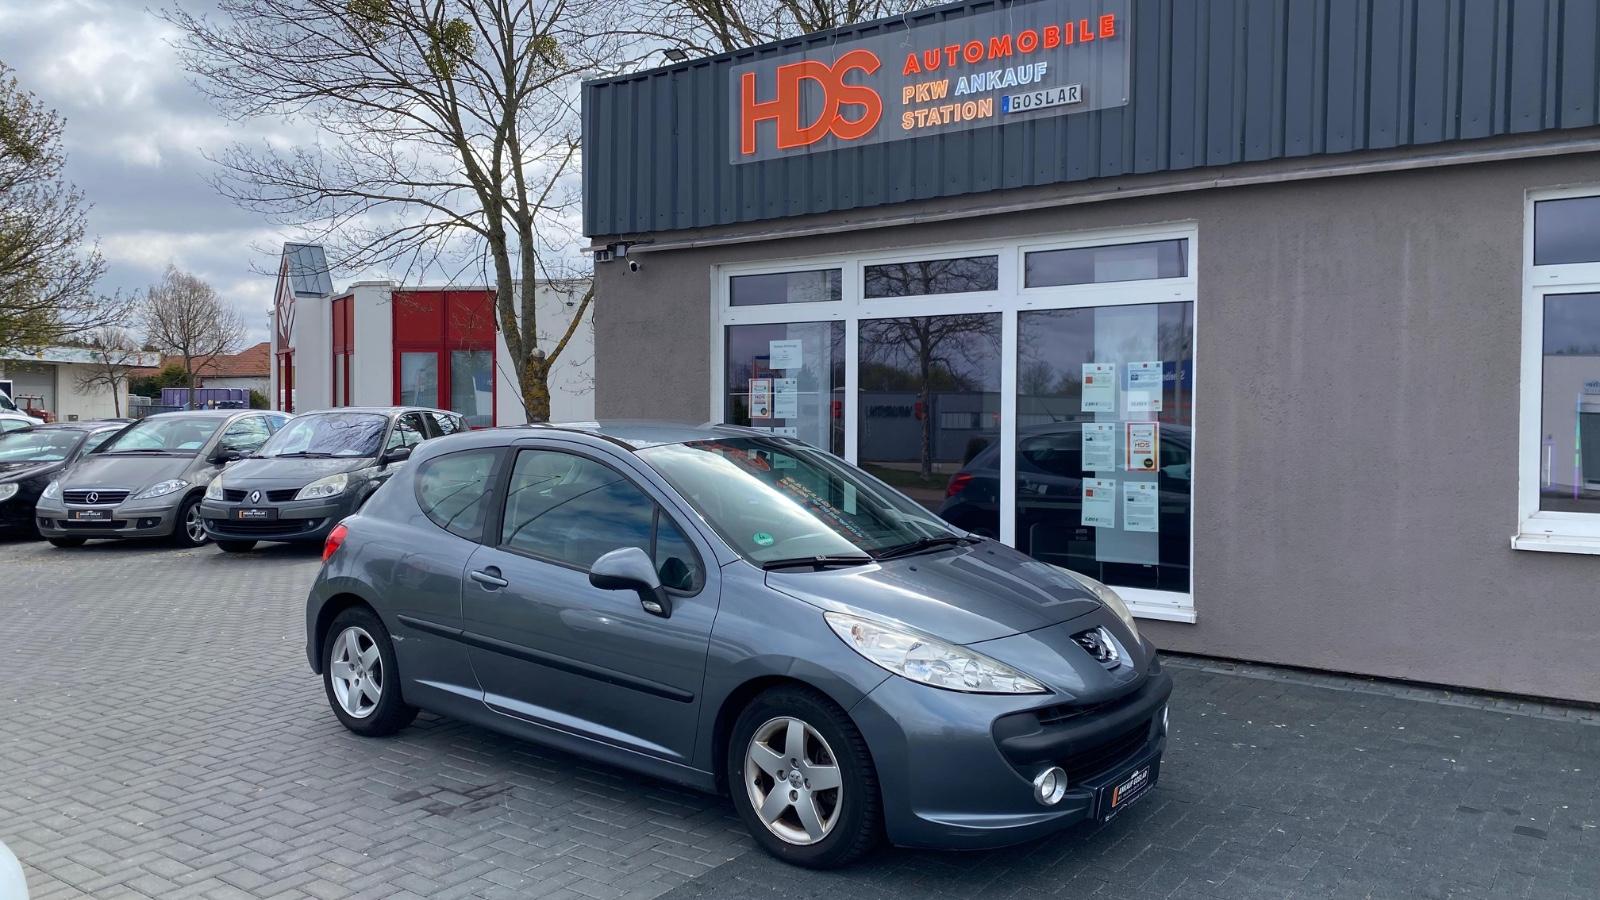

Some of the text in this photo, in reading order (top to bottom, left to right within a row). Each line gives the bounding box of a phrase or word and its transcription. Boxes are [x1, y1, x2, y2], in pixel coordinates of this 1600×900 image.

[902, 14, 1115, 76] AUTOMOBILE
[742, 49, 883, 155] HDS
[902, 61, 1048, 105] PKW ANKAUF
[902, 86, 1078, 130] STATION GOSLAR
